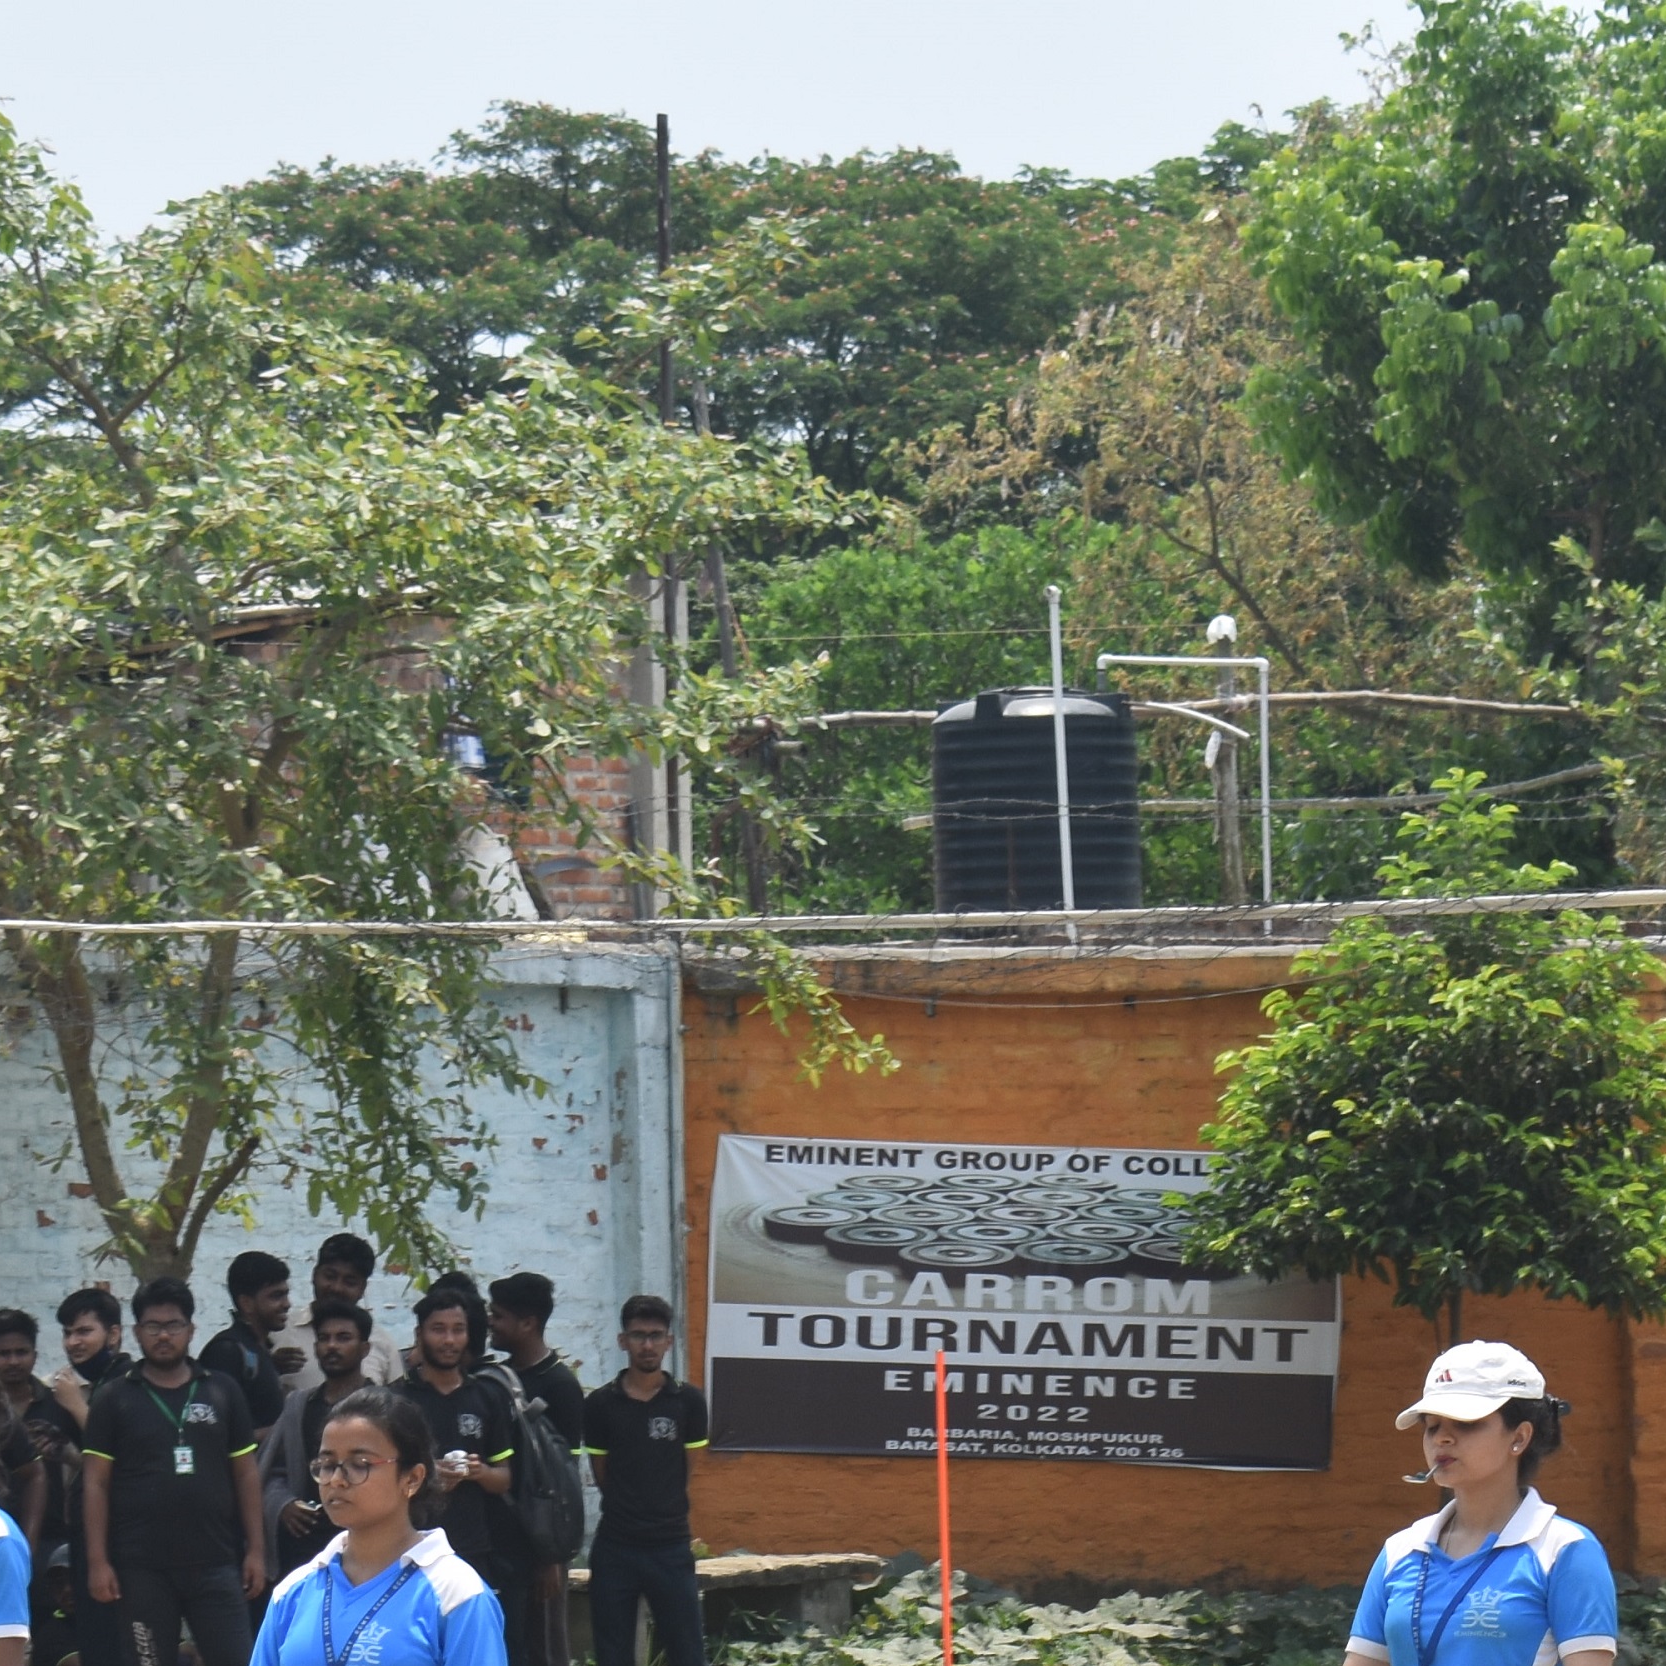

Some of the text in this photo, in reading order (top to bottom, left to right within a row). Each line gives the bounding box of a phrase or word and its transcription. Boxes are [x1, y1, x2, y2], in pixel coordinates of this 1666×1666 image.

[765, 1144, 1219, 1177] EMINENT GROUP OF COLL
[844, 1269, 1212, 1315] CARROM
[748, 1311, 1309, 1363] TOURNAMENT
[884, 1370, 1198, 1400] EMINENCE
[976, 1403, 1091, 1422] 2022
[885, 1439, 987, 1454] BARASAT,
[1104, 1446, 1141, 1457] 700
[1146, 1447, 1184, 1458] 126
[1027, 1430, 1164, 1444] MOSHPUKUR
